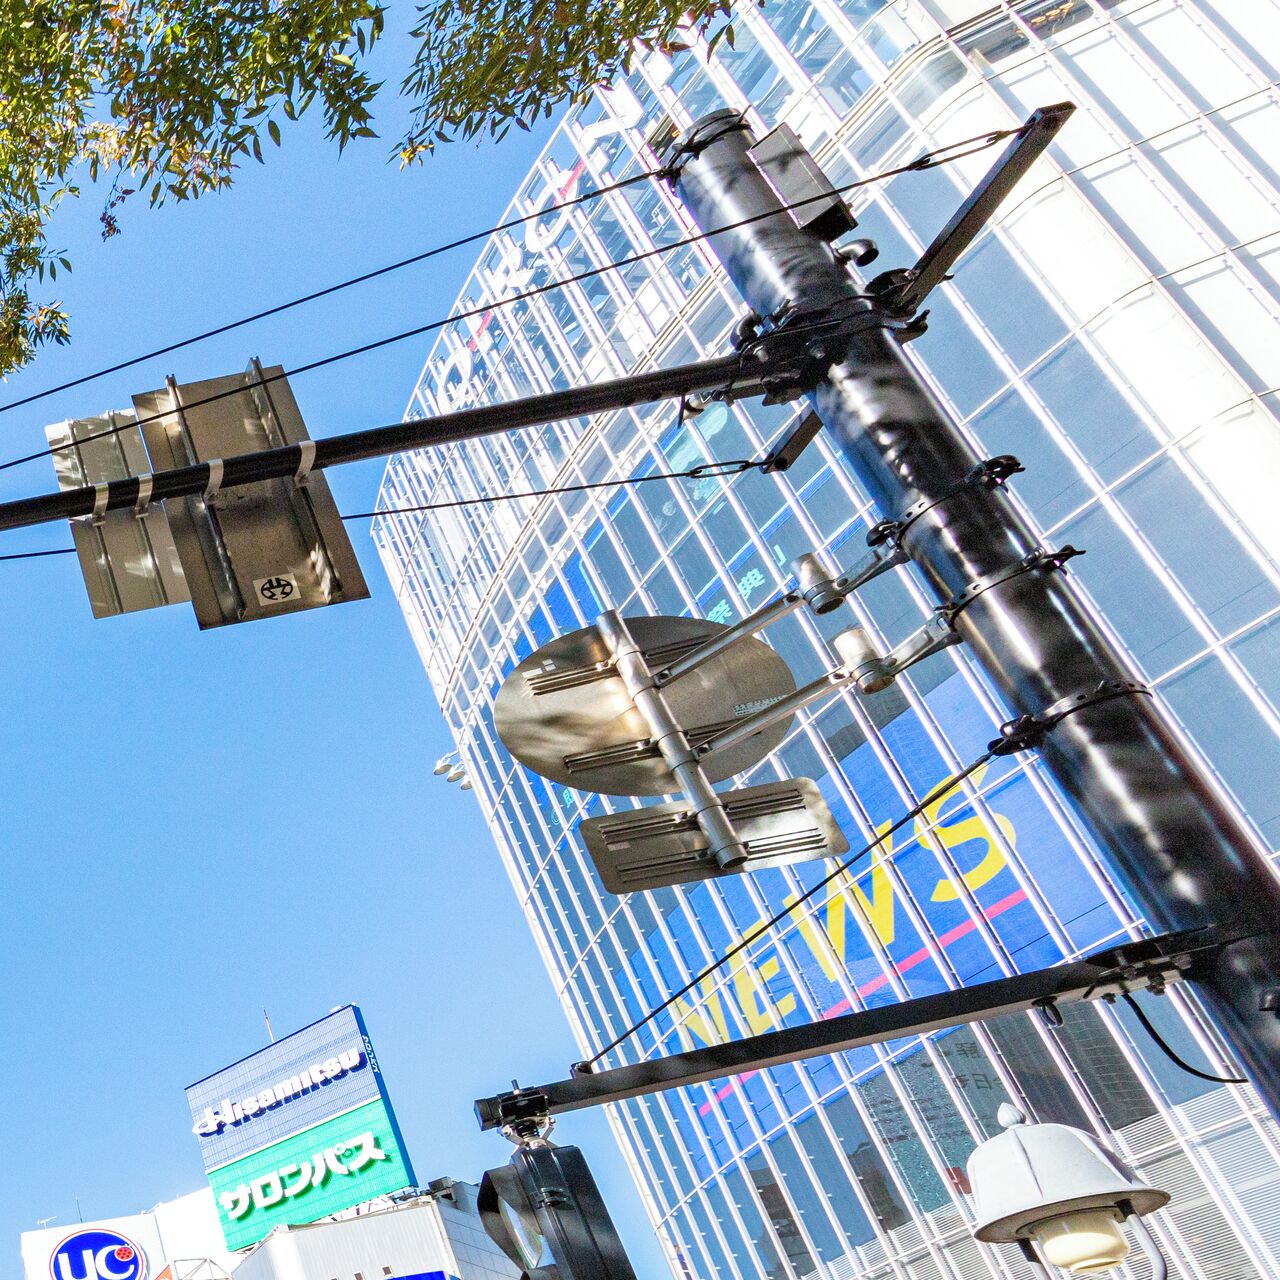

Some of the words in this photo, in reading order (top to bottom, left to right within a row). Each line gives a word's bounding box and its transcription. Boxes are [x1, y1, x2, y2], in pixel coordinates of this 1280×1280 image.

[678, 763, 1018, 1080] NEWS
[191, 1047, 362, 1136] Hisamitsu
[219, 1130, 387, 1222] サロンパス
